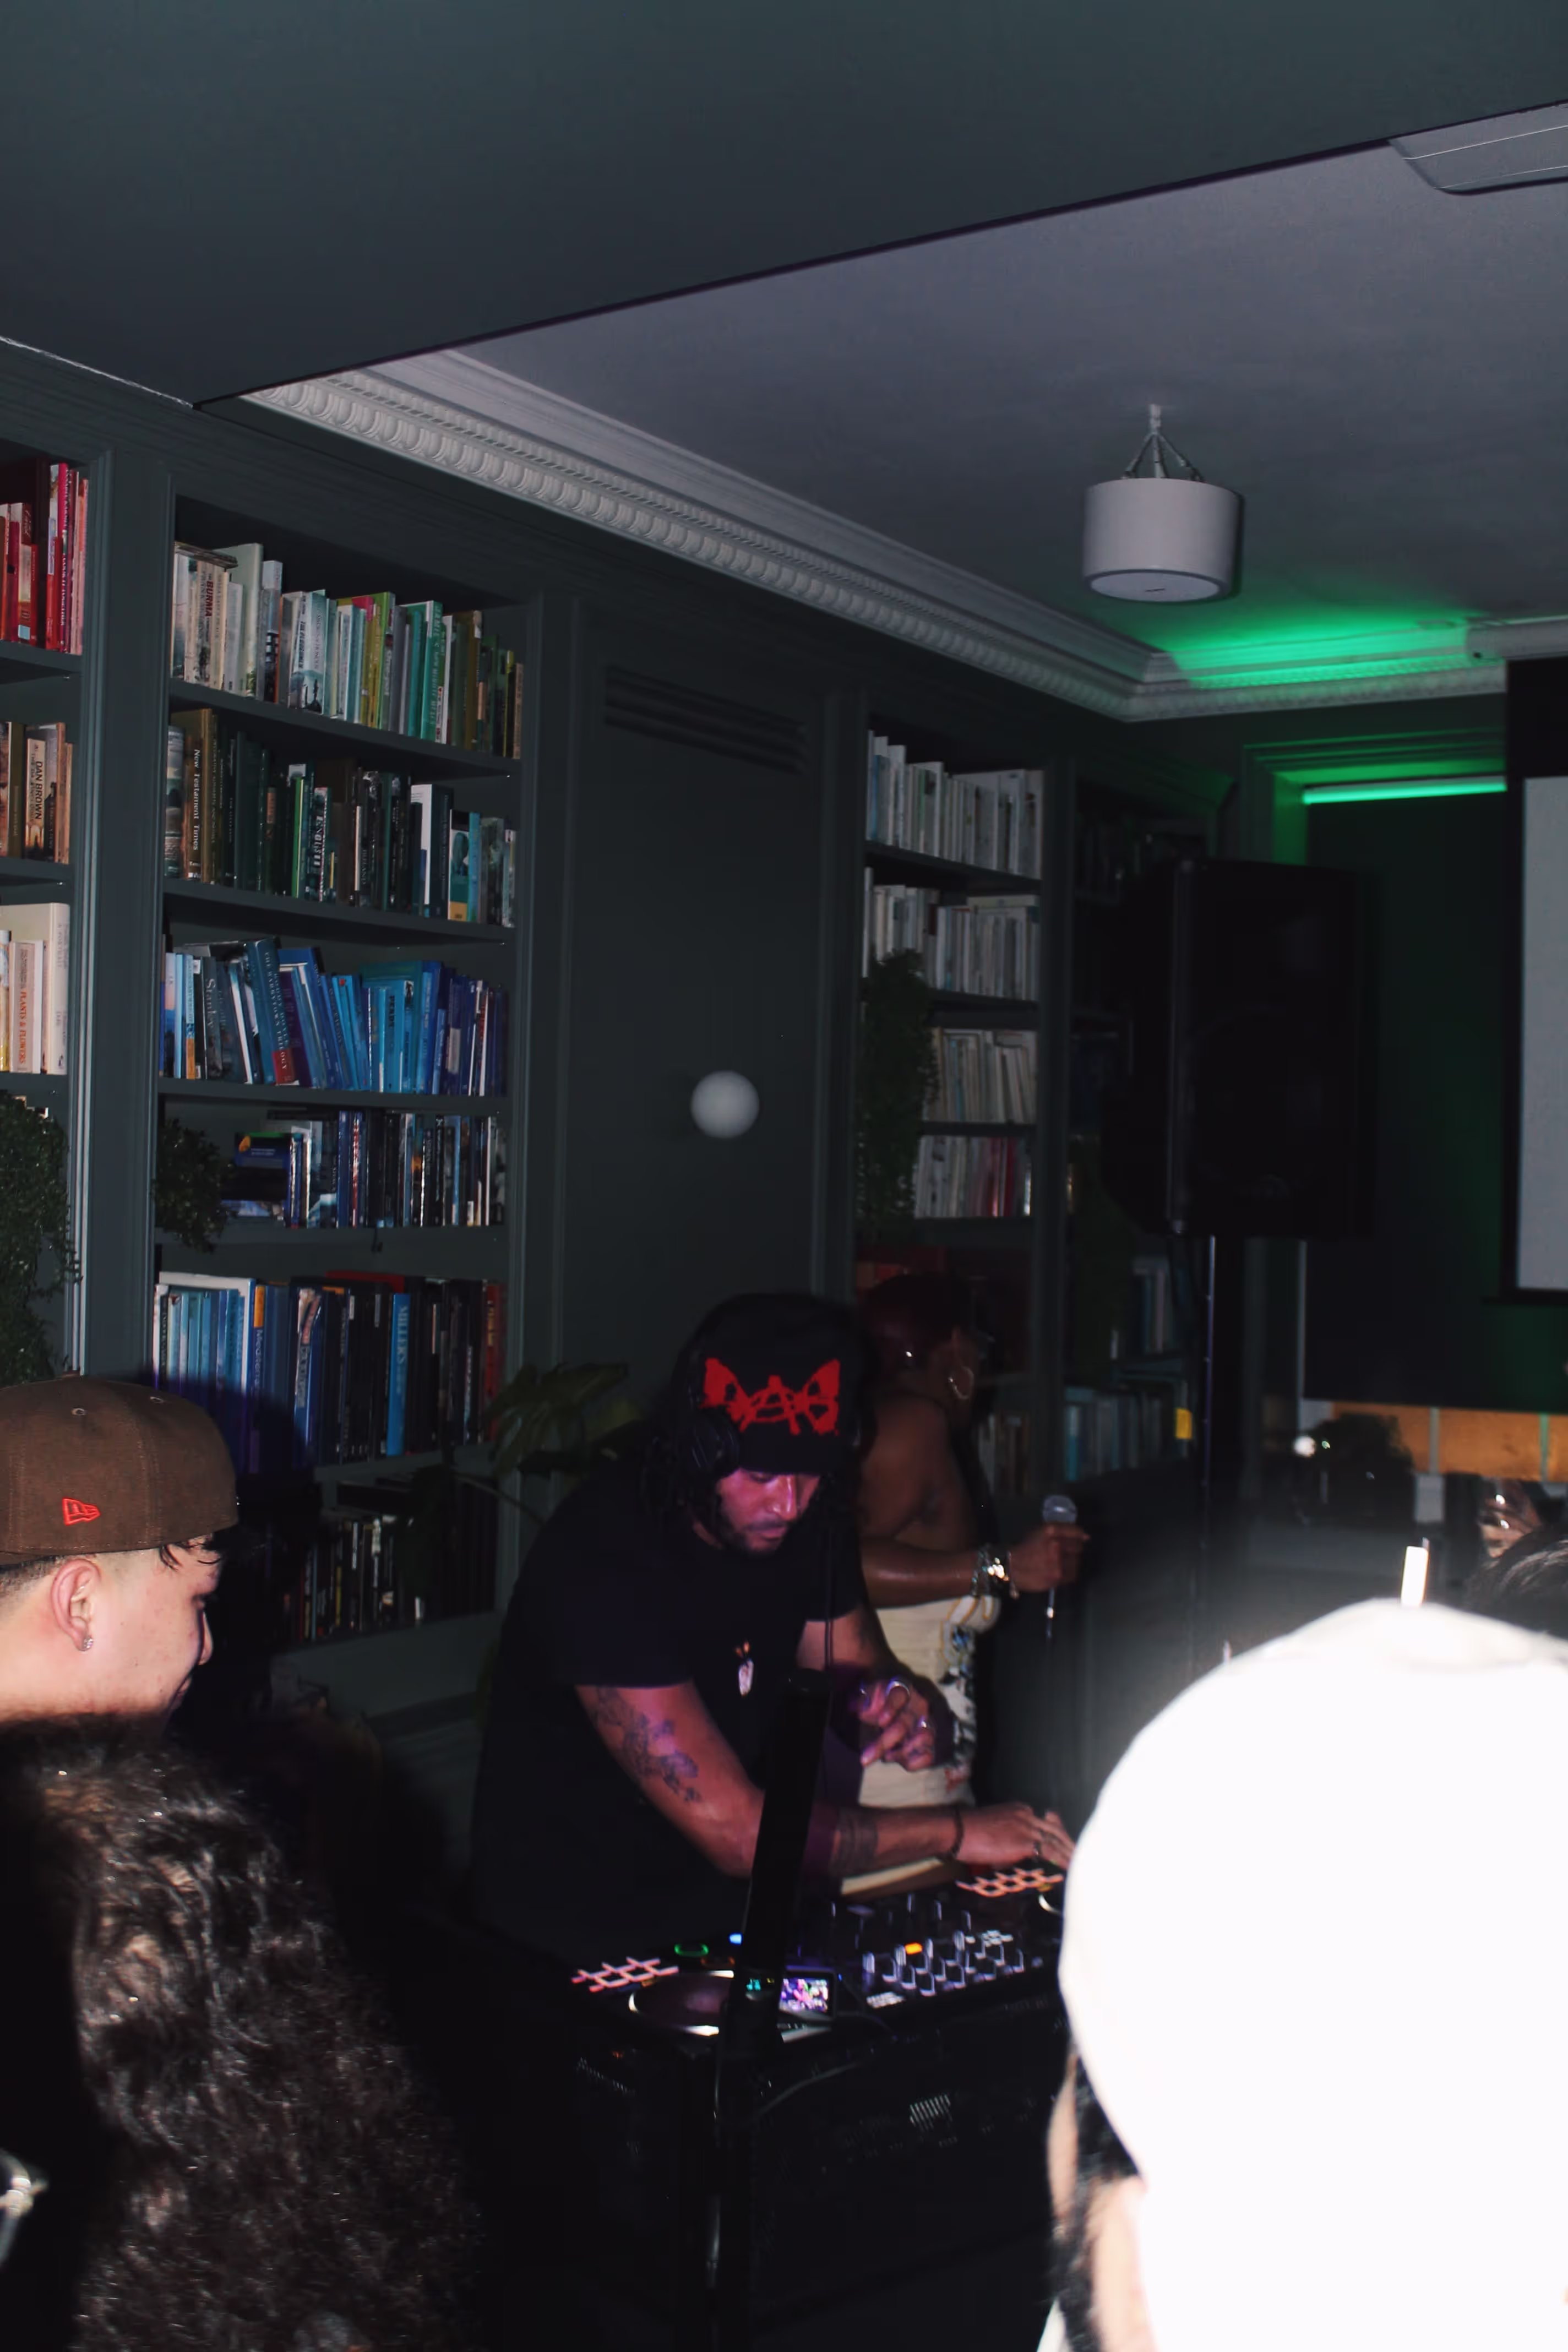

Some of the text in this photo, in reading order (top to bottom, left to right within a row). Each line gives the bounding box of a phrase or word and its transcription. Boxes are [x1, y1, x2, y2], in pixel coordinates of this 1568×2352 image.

[205, 581, 214, 617] BURMA
[35, 761, 43, 781] DAN
[19, 991, 28, 1020] PLANTS
[204, 978, 216, 1029] Stanley
[18, 1030, 27, 1064] FLOWERS
[276, 1031, 287, 1070] TRILOGY
